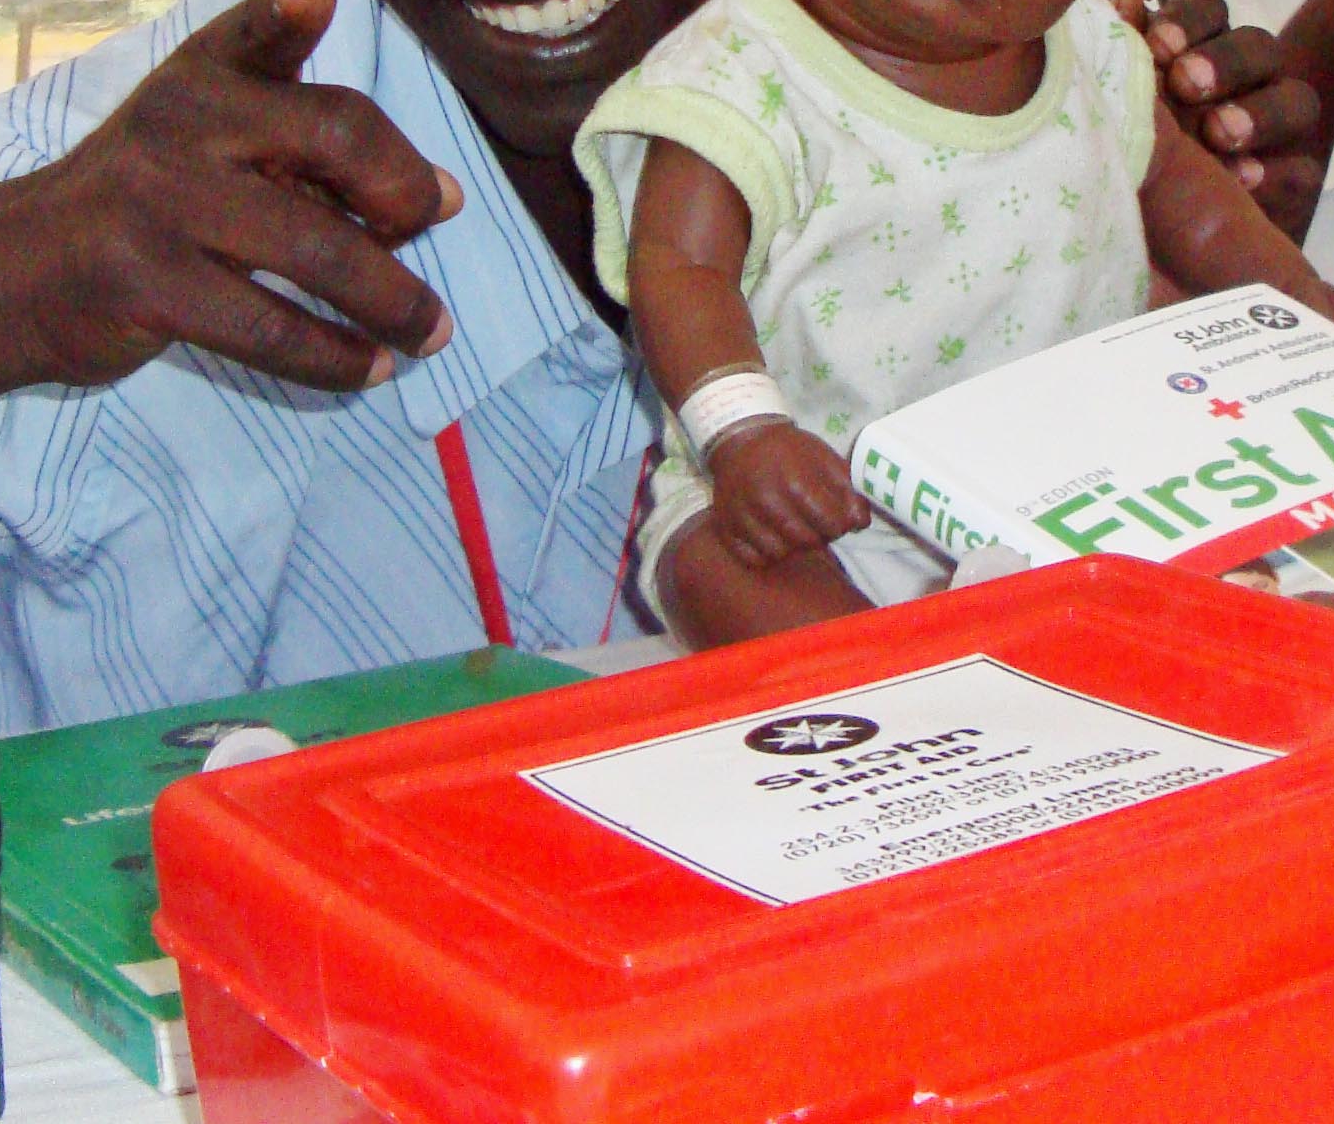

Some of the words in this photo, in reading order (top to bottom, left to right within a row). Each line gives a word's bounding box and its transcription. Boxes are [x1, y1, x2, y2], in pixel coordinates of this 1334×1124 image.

[1174, 329, 1203, 345] St
[1201, 316, 1250, 338] John
[1191, 326, 1262, 353] Ambulance
[1032, 437, 1320, 558] First
[1039, 466, 1116, 506] EDITION
[754, 768, 828, 791] St
[831, 728, 985, 771] John
[809, 761, 907, 795] FIRST
[916, 745, 979, 765] AID
[863, 775, 930, 796] First
[930, 767, 963, 777] to
[875, 789, 943, 811] Pilot
[878, 802, 1039, 852] Emergency
[783, 833, 866, 860] (0720)
